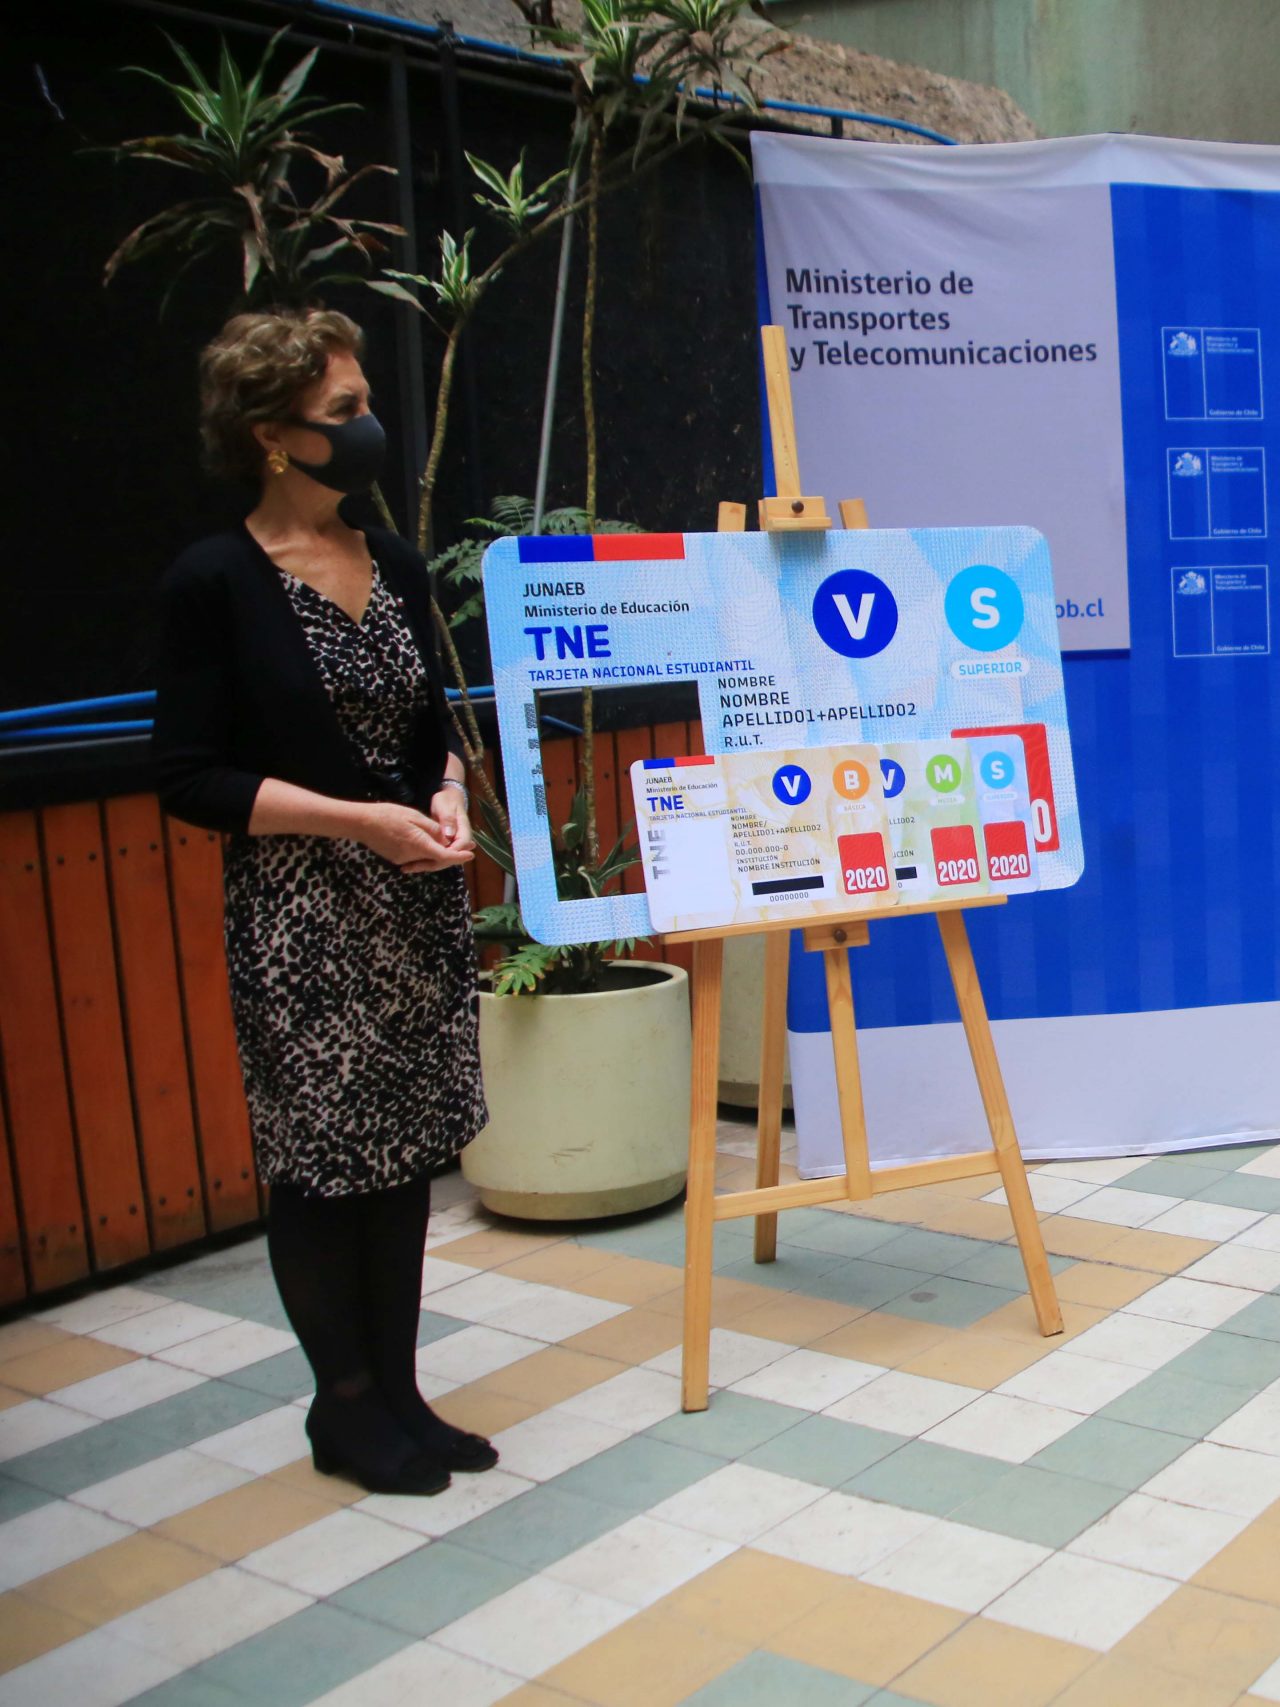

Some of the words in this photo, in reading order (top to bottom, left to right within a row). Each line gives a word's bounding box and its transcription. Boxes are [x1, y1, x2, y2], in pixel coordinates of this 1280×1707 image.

[786, 268, 931, 295] Ministerio
[940, 271, 974, 295] de
[787, 304, 950, 336] Transportes
[790, 346, 805, 371] y
[812, 340, 1097, 366] Telecomunicaciones
[523, 582, 585, 597] JUNAEB
[524, 605, 597, 618] Ministerio
[601, 603, 617, 615] de
[621, 600, 690, 614] Educación
[831, 593, 875, 640] V
[969, 587, 1000, 629] S
[523, 624, 612, 661] TNE
[528, 668, 588, 681] TARJETA
[592, 664, 663, 679] NACIONAL
[666, 660, 755, 675] ESTUDIANTIL
[958, 661, 1022, 676] SUPERIOR
[718, 675, 775, 689] NOMBRE
[720, 691, 790, 708] NOMBRE
[722, 703, 917, 728] APELLIDO1+APELLIDO2
[724, 735, 763, 748] R.U.T.
[645, 776, 673, 785] JUNAEB
[843, 770, 860, 790] B
[933, 764, 953, 784] M
[990, 760, 1005, 780] S
[646, 785, 678, 794] Ministerio
[687, 783, 718, 791] Educación
[781, 775, 801, 797] V
[647, 795, 685, 812] TNE
[1030, 799, 1052, 843] 0
[647, 830, 670, 880] TNE
[738, 863, 769, 873] NOMBRE
[771, 857, 821, 870] INSTITUCIÓN
[989, 854, 1028, 877] 2020
[845, 866, 887, 891] 2020
[938, 858, 979, 883] 2020
